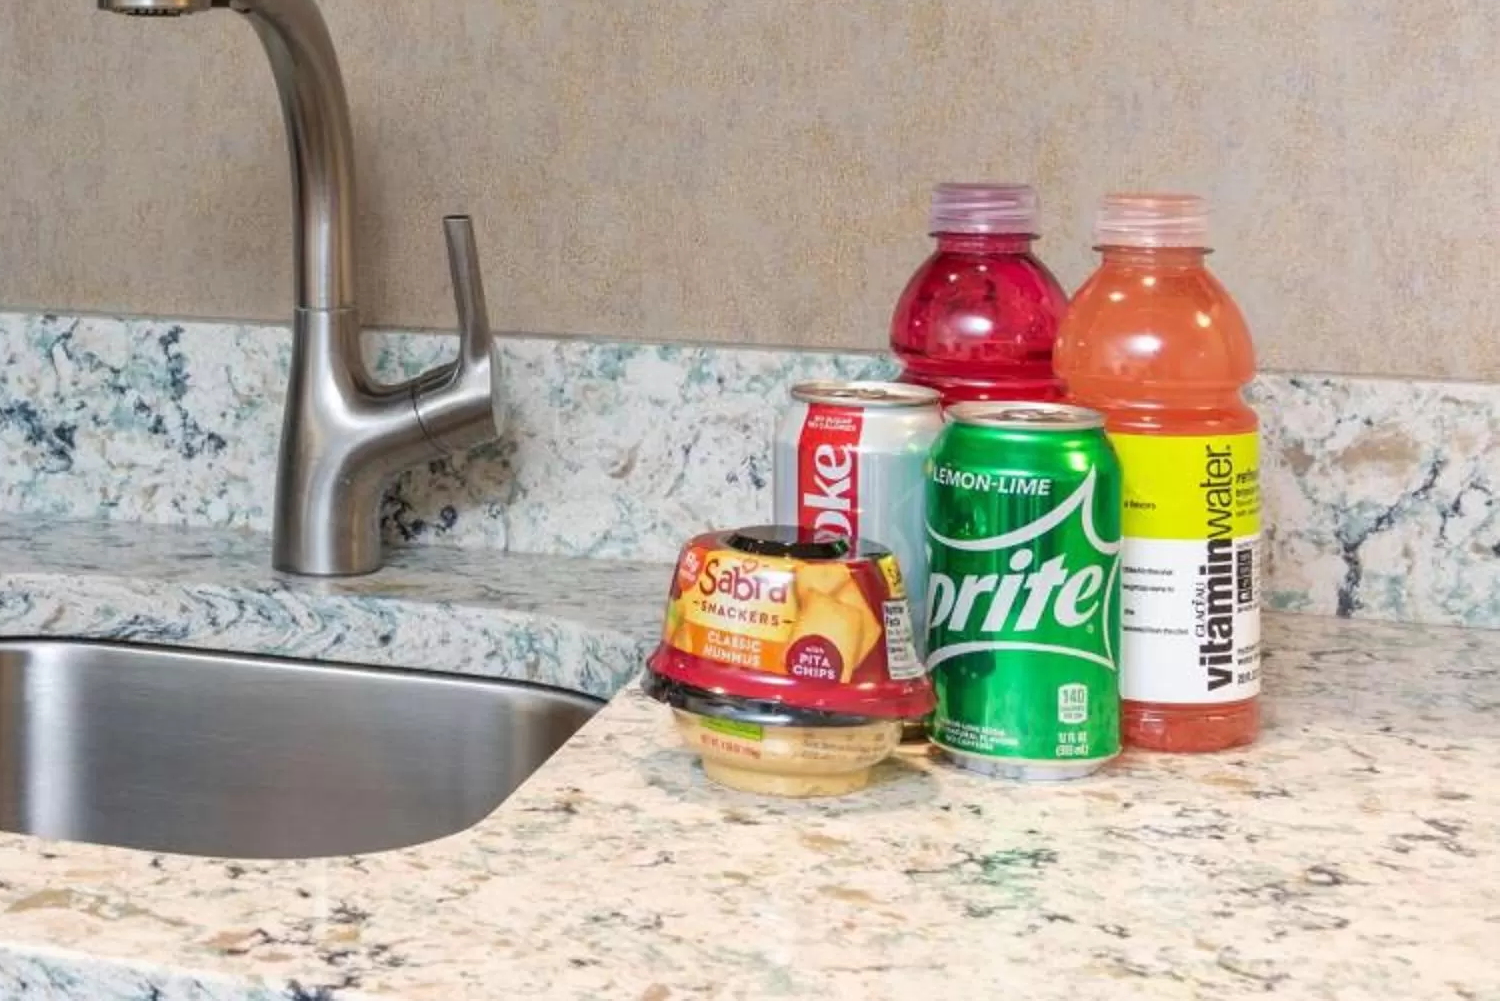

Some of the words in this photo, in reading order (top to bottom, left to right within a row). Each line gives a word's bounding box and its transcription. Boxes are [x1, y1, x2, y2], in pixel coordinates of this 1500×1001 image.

[803, 443, 853, 544] oke
[932, 466, 1052, 497] LEMON-LIME
[699, 557, 788, 604] Sabra
[926, 548, 1104, 637] prite
[700, 601, 780, 627] SNACKERS
[707, 629, 762, 653] CLASSIC
[703, 645, 761, 667] HUMMUS
[798, 652, 832, 668] PITA
[791, 665, 837, 681] CHIPS
